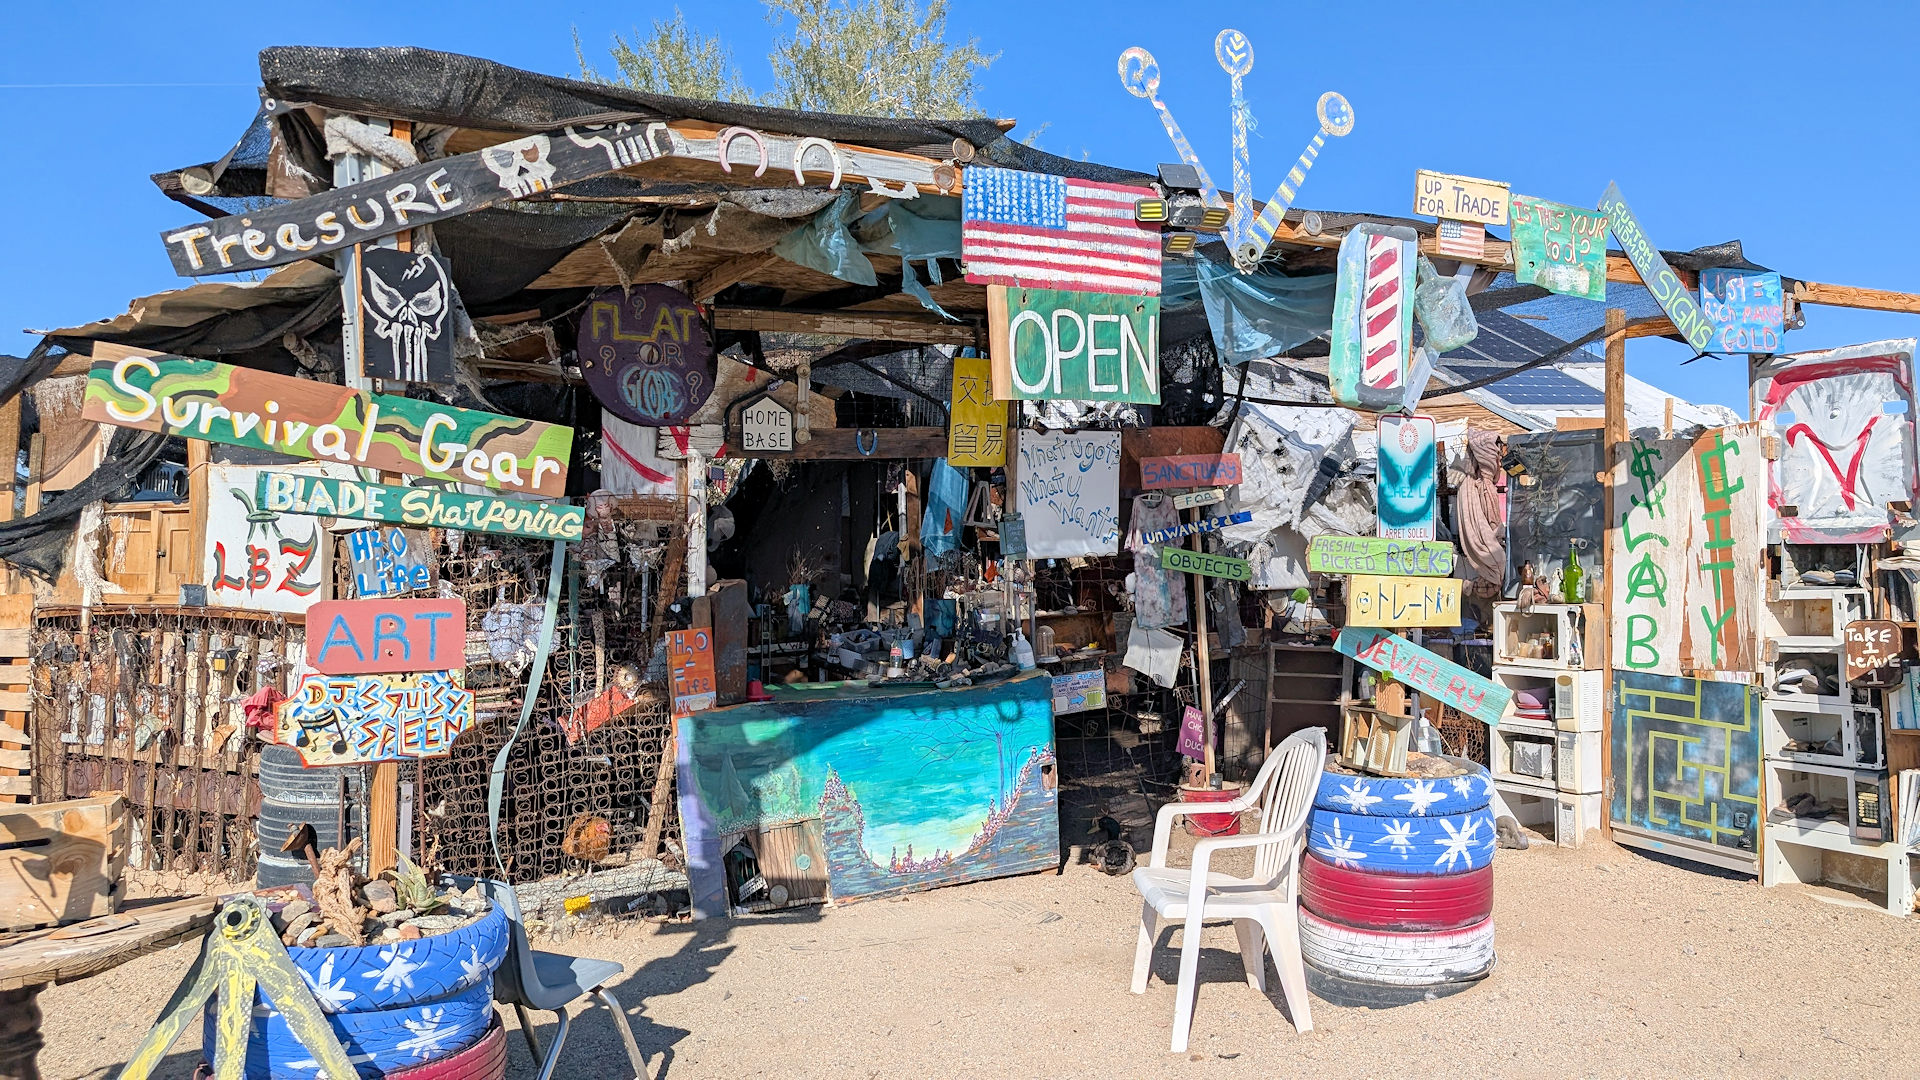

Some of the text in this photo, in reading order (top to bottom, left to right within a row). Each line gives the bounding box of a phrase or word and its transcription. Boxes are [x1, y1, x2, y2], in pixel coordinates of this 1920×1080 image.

[1419, 186, 1500, 218] FOR TRADE
[1424, 179, 1442, 195] UP
[1513, 201, 1608, 240] IS THIS YOUR
[1615, 201, 1654, 264] CUSTOM
[591, 301, 697, 342] FLAT
[1651, 270, 1713, 349] SIGNS
[1009, 308, 1157, 395] OPEN
[1722, 325, 1778, 353] GOLD
[622, 366, 684, 420] GLOBE
[106, 356, 561, 489] Survival Gear
[745, 410, 787, 427] HOME
[745, 432, 789, 448] BASE
[951, 423, 1003, 461] 貿易
[1020, 466, 1064, 505] What
[1143, 462, 1237, 484] SANCTUARY
[264, 472, 387, 519] BLADE
[1315, 538, 1370, 555] FRESHLY
[1385, 528, 1429, 539] ARRET SOLEIL
[212, 521, 320, 598] LBZ
[1169, 553, 1242, 577] OBJECTS
[1321, 542, 1451, 575] PICKED ROCKS
[358, 564, 431, 599] Life
[1378, 582, 1433, 620] トレード
[318, 612, 452, 663] ART
[1846, 627, 1891, 643] TaKE
[1862, 641, 1879, 655] 1
[676, 678, 711, 696] Life
[1356, 633, 1487, 713] JEWELRY
[1866, 668, 1885, 685] 1
